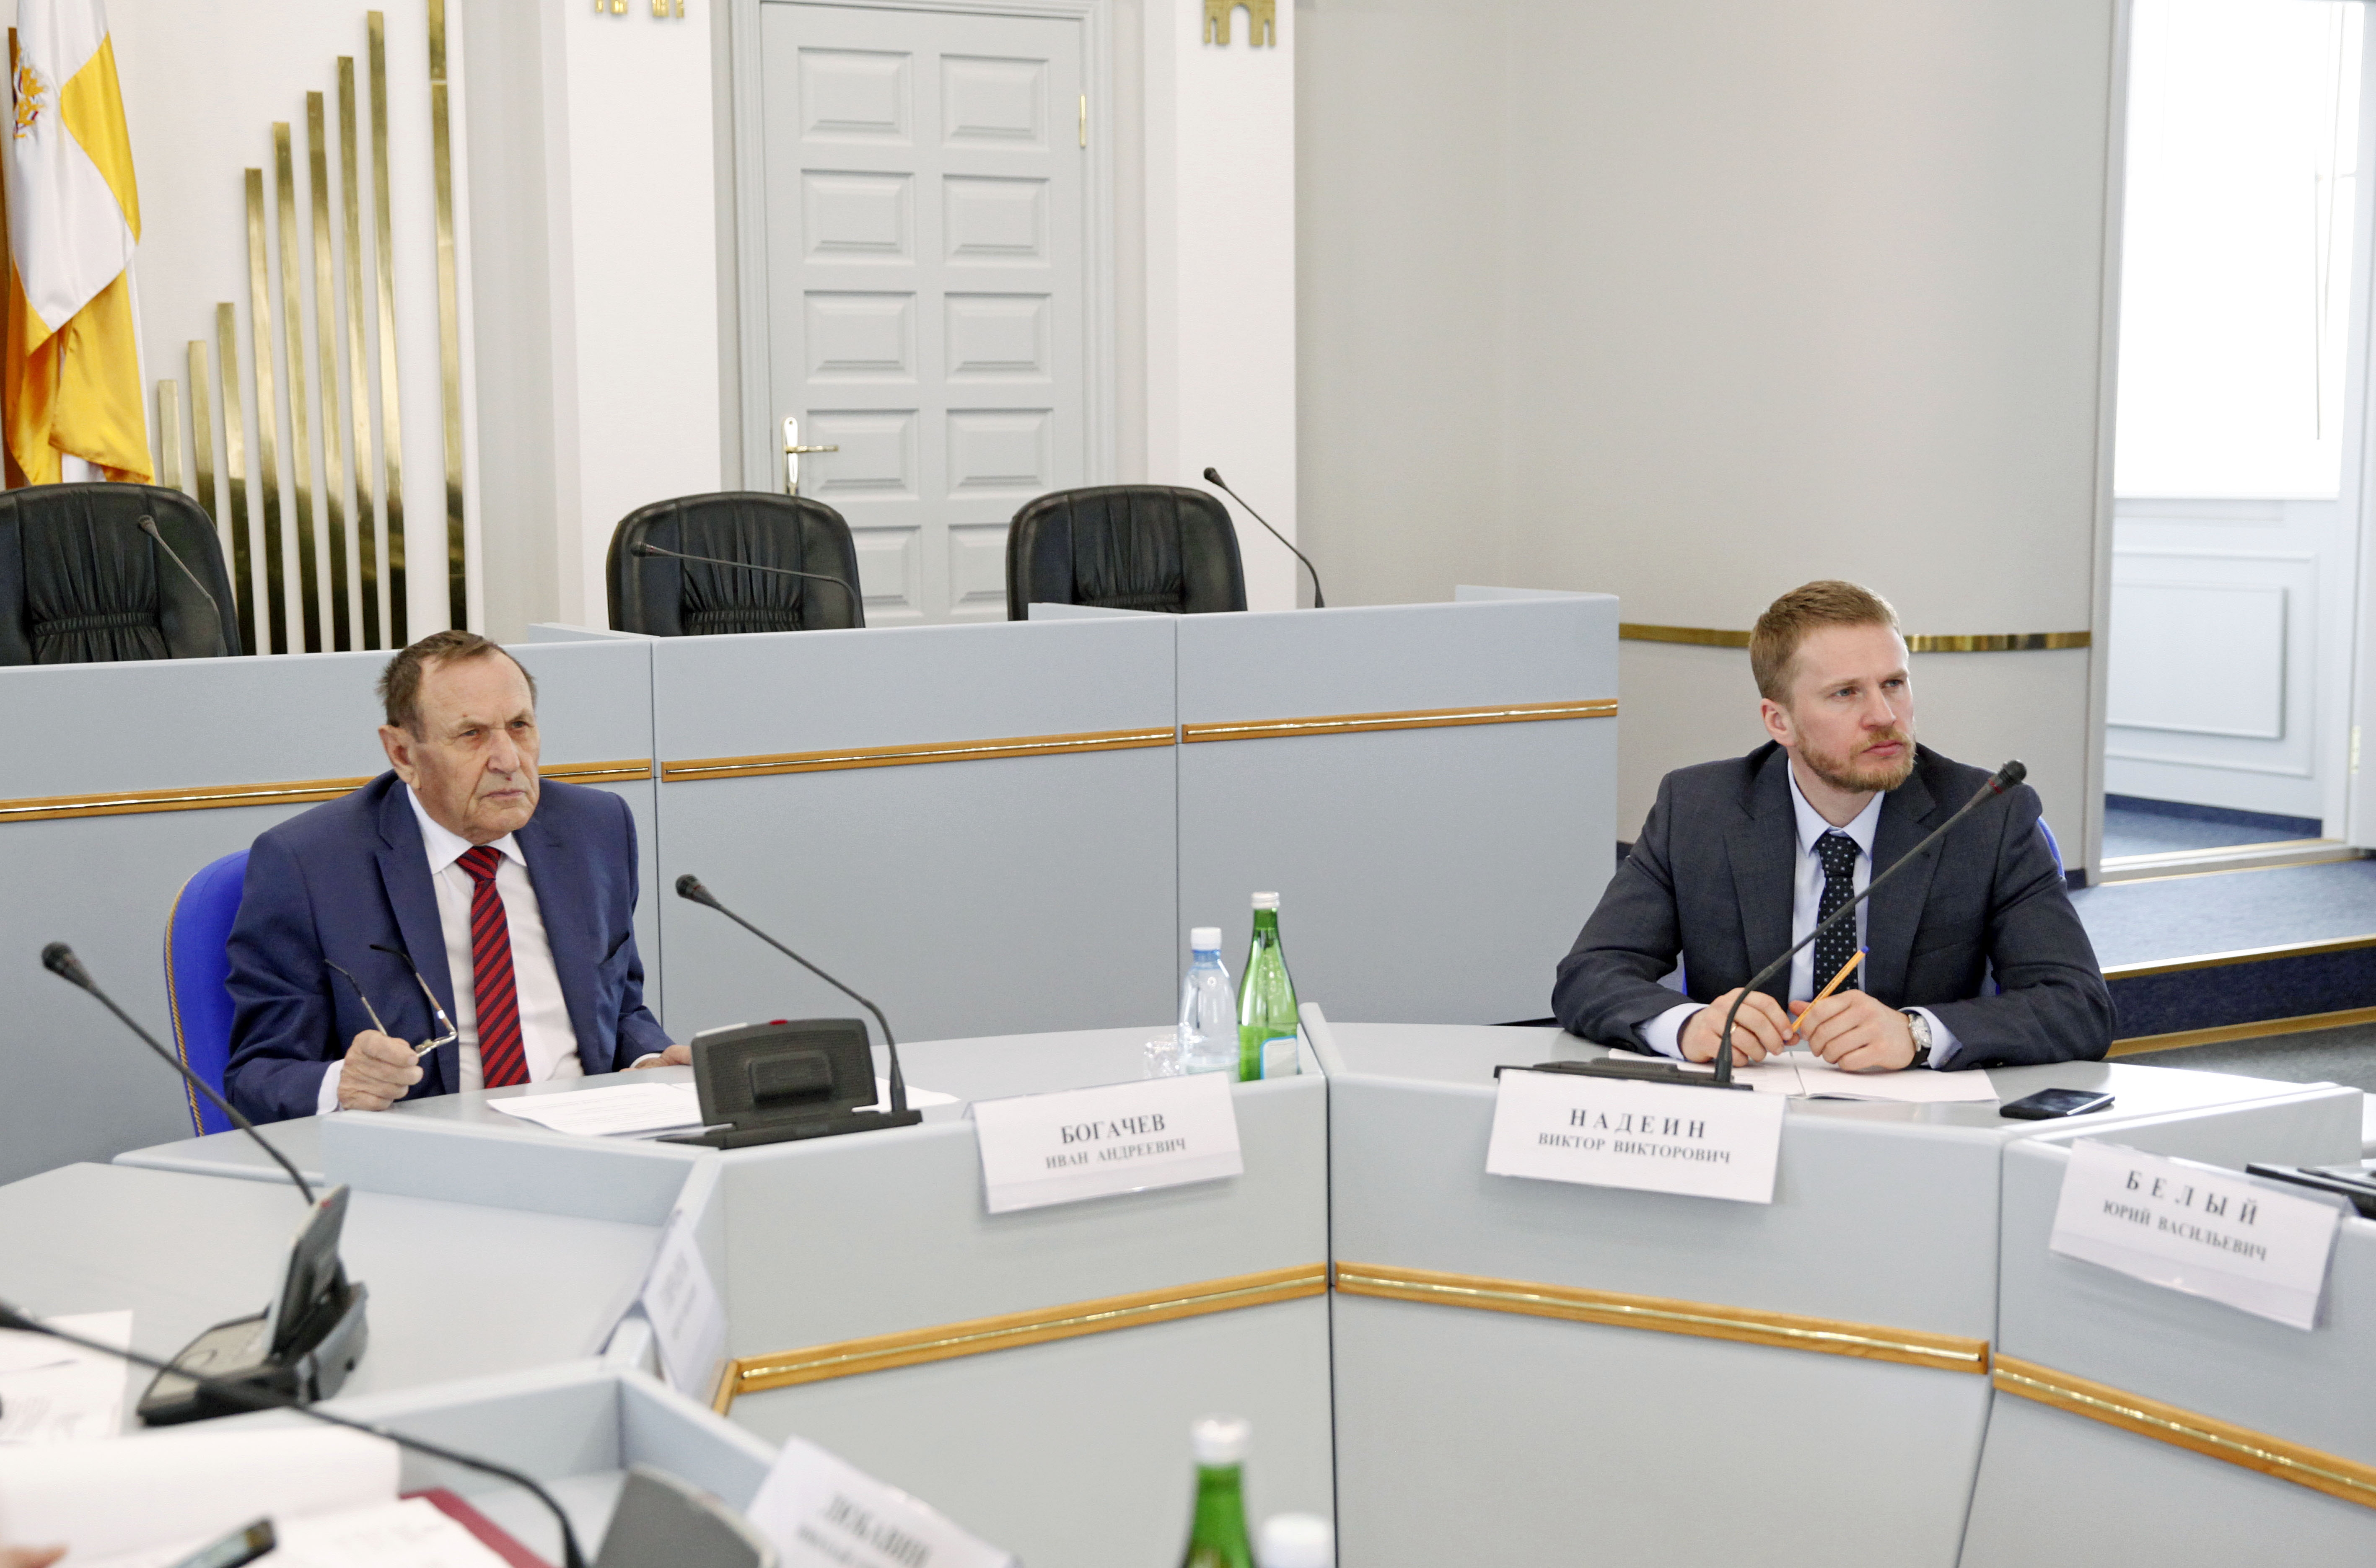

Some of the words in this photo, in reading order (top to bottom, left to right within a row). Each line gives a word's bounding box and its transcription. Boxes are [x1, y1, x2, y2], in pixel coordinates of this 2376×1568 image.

[1061, 1113, 1166, 1144] БОГАЧЕВ
[1569, 1107, 1706, 1139] НАДЕИН
[1045, 1151, 1088, 1168] ИВАН
[1097, 1137, 1186, 1161] АНДРЕЕВИЧ
[1538, 1132, 1606, 1151] ВИКТОР
[1613, 1139, 1731, 1164] ВИКТОРОВИЧ
[2126, 1170, 2258, 1226] БЕЛЫЙ
[2103, 1200, 2151, 1226] ЮРИЙ
[2158, 1216, 2267, 1261] ВАСИЛЬЕВИЧ
